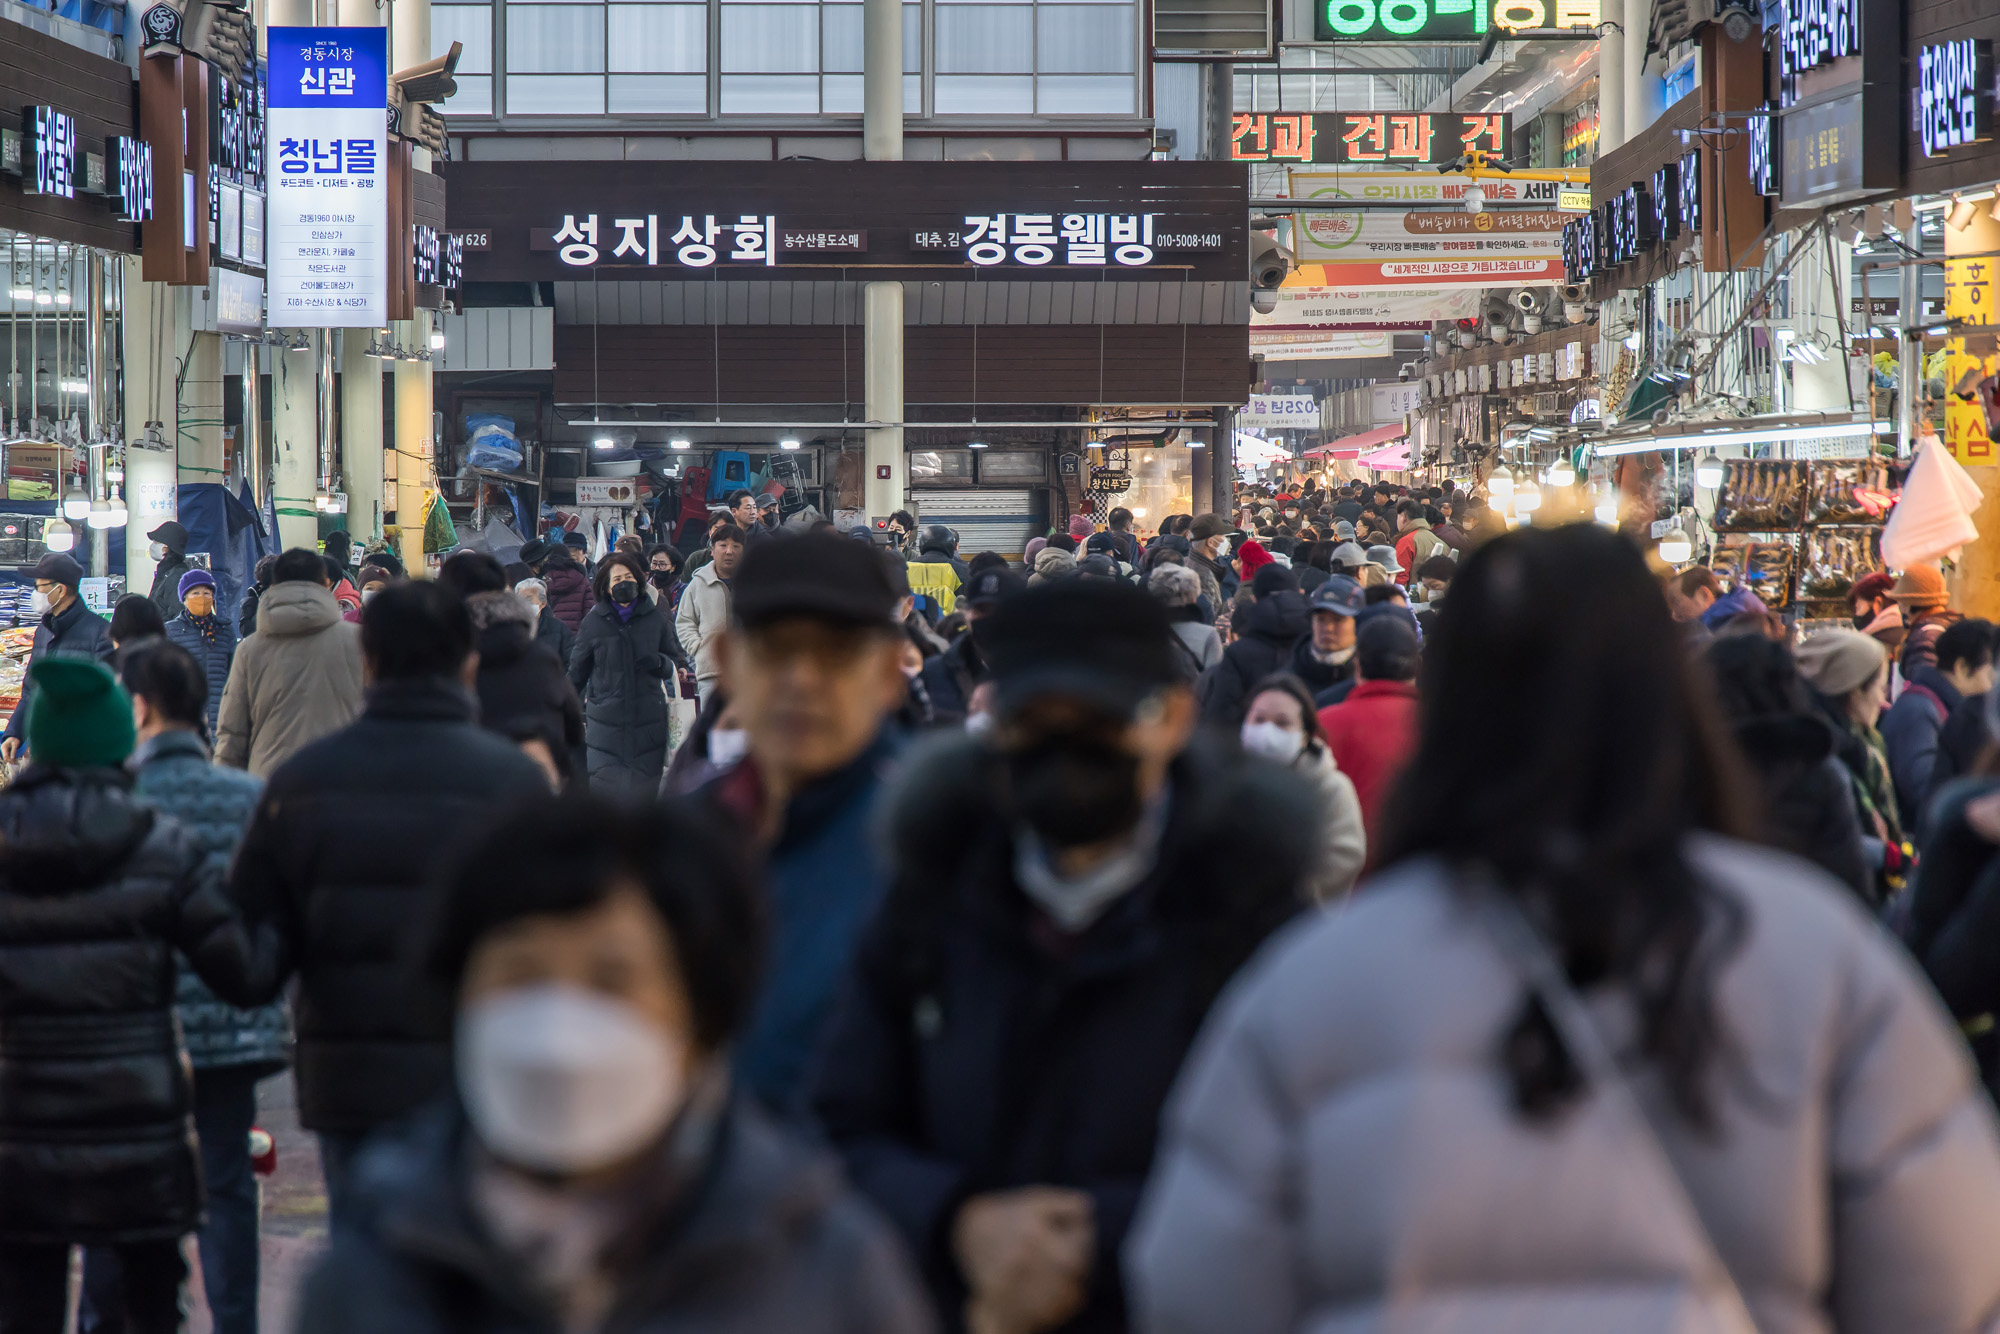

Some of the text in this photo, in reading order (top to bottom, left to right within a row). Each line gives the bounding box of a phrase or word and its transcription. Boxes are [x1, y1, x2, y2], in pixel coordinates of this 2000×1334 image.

[300, 47, 354, 61] 경동시장
[299, 67, 356, 95] 신관
[279, 138, 376, 174] 청년몰
[280, 178, 374, 188] 푸드코트 디저트 공방
[1563, 196, 1580, 205] CCTV
[1477, 217, 1492, 228] 더
[311, 231, 343, 239] 인삼상가
[552, 214, 859, 266] 성지상회 농수산물도소매
[962, 213, 1153, 265] 경동웰빙
[1157, 234, 1222, 247] 010-5008-1401
[1486, 240, 1529, 249] 확인하세요.
[308, 264, 346, 273] 작은도서관
[1433, 263, 1469, 273] 시장으로
[300, 281, 354, 290] 건어물도매상가
[287, 298, 367, 307] 지하 수산시장 & 식당가
[1065, 463, 1075, 473] 25
[1092, 478, 1129, 490] 창신푸드
